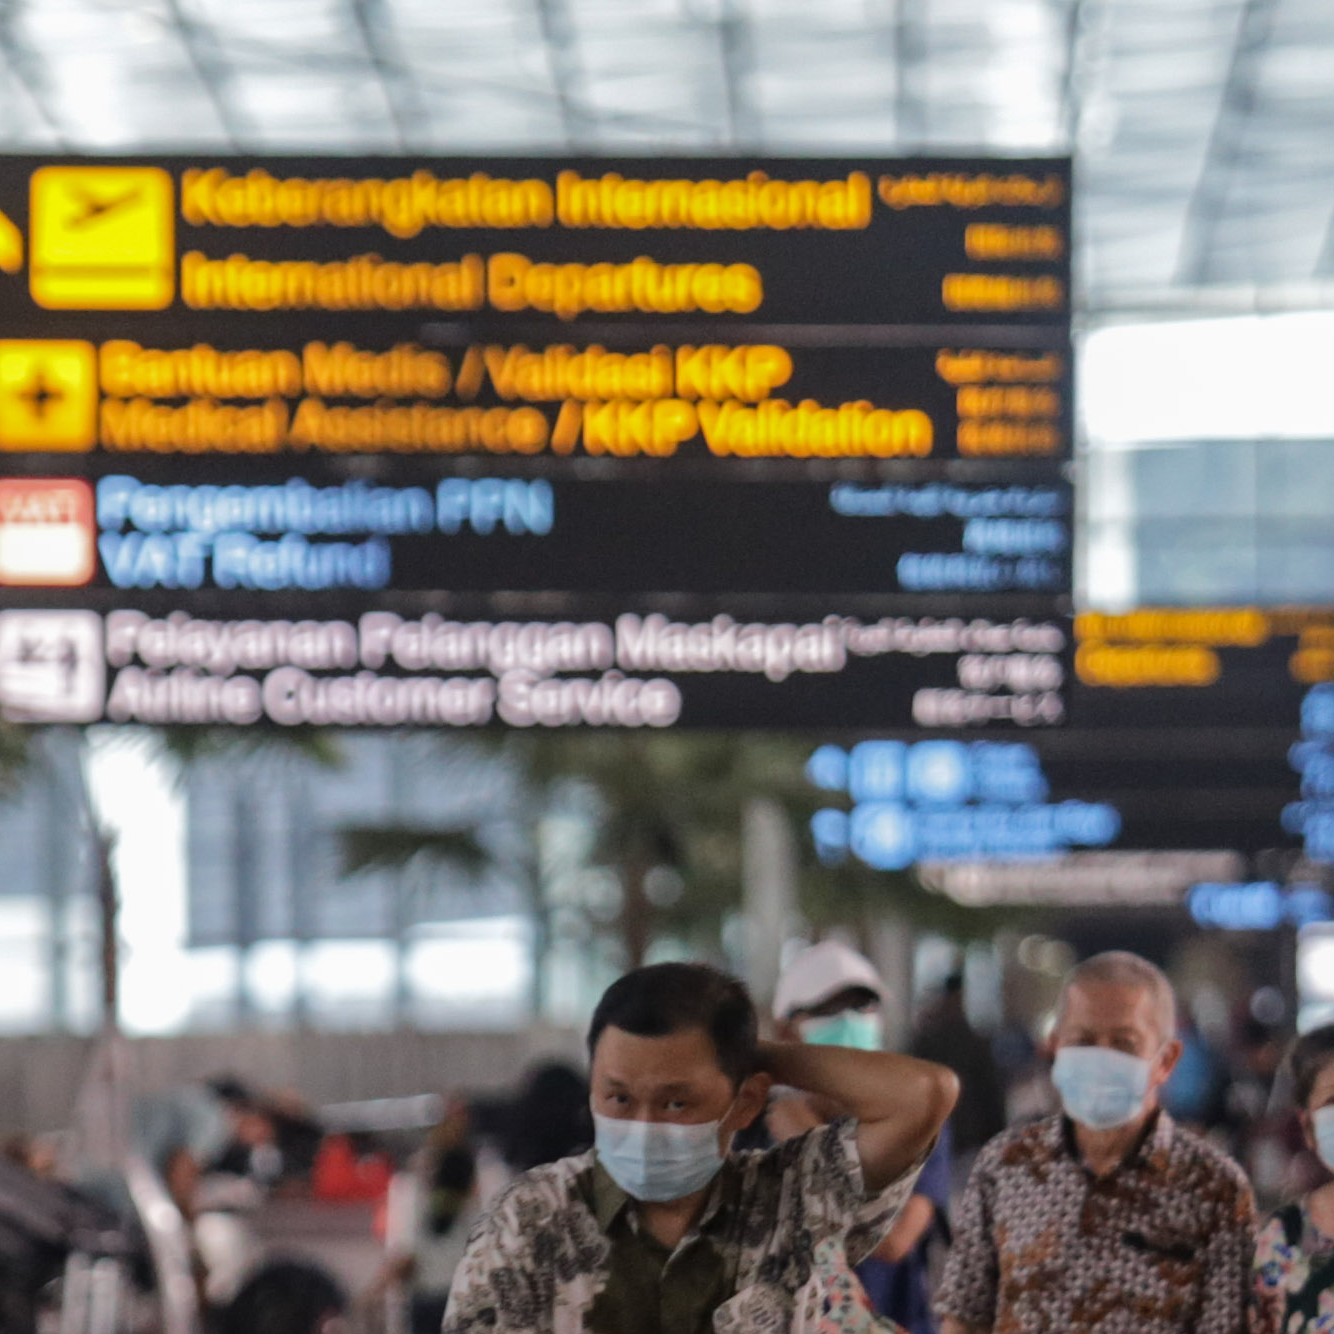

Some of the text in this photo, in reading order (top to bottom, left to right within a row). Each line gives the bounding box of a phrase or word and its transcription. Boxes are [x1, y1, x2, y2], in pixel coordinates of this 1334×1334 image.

[180, 251, 763, 318] International Departures
[675, 345, 794, 401] KKP
[100, 398, 288, 453] Medical
[288, 398, 548, 453] Assistance
[583, 398, 698, 457] KKP
[698, 398, 933, 458] Validation
[98, 531, 390, 589] VAT Refund
[105, 610, 357, 674] Pelayanan
[107, 667, 682, 727] Airline Customer Service
